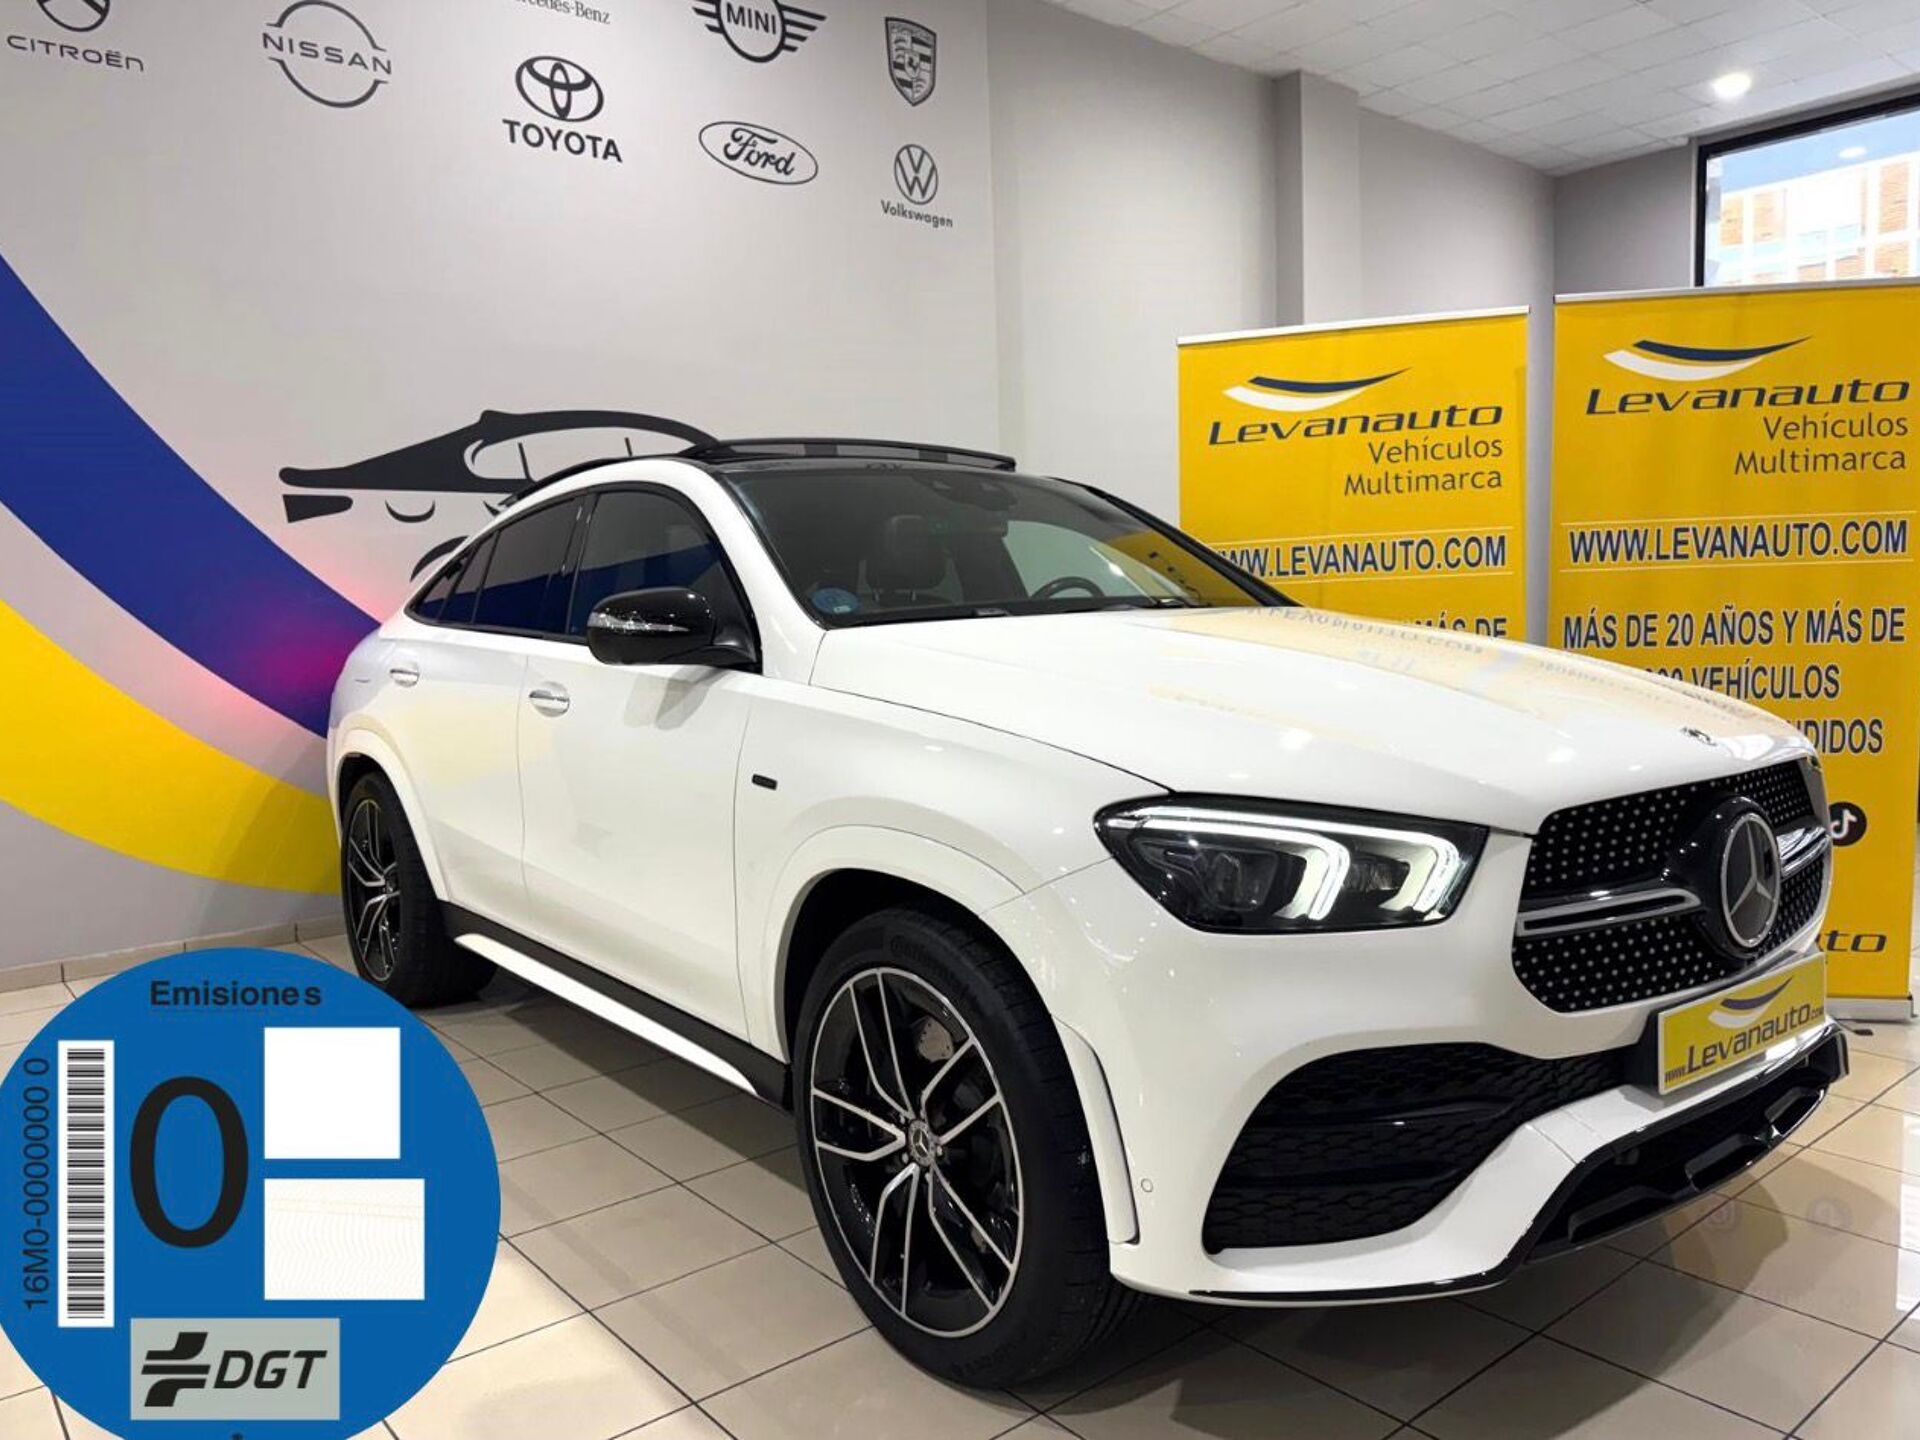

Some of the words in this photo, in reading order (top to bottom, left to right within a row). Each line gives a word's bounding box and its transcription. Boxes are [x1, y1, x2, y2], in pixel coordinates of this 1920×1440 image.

[727, 6, 776, 35] MINI
[262, 32, 392, 75] NISSAN
[503, 119, 623, 163] TOYOTA
[723, 127, 795, 176] Ford
[881, 199, 953, 228] Volkswagen
[1586, 378, 1910, 416] Levanauto
[1208, 405, 1503, 446] Levanauto
[1763, 412, 1909, 441] Vehículos
[1368, 435, 1503, 464] Vehículos
[1734, 448, 1906, 475] Multimarca
[1344, 470, 1502, 497] Multimarca
[1570, 520, 1907, 563] WWW.LEVANAUTO.COM
[1563, 608, 1617, 649] MÁS
[1625, 613, 1658, 647] DE
[1666, 613, 1694, 646] 20
[1701, 605, 1774, 646] AÑOS
[1782, 611, 1799, 644] Y
[1805, 601, 1863, 643] MÁS
[1871, 608, 1905, 641] DE
[1692, 658, 1840, 700] VEHÍCULOS
